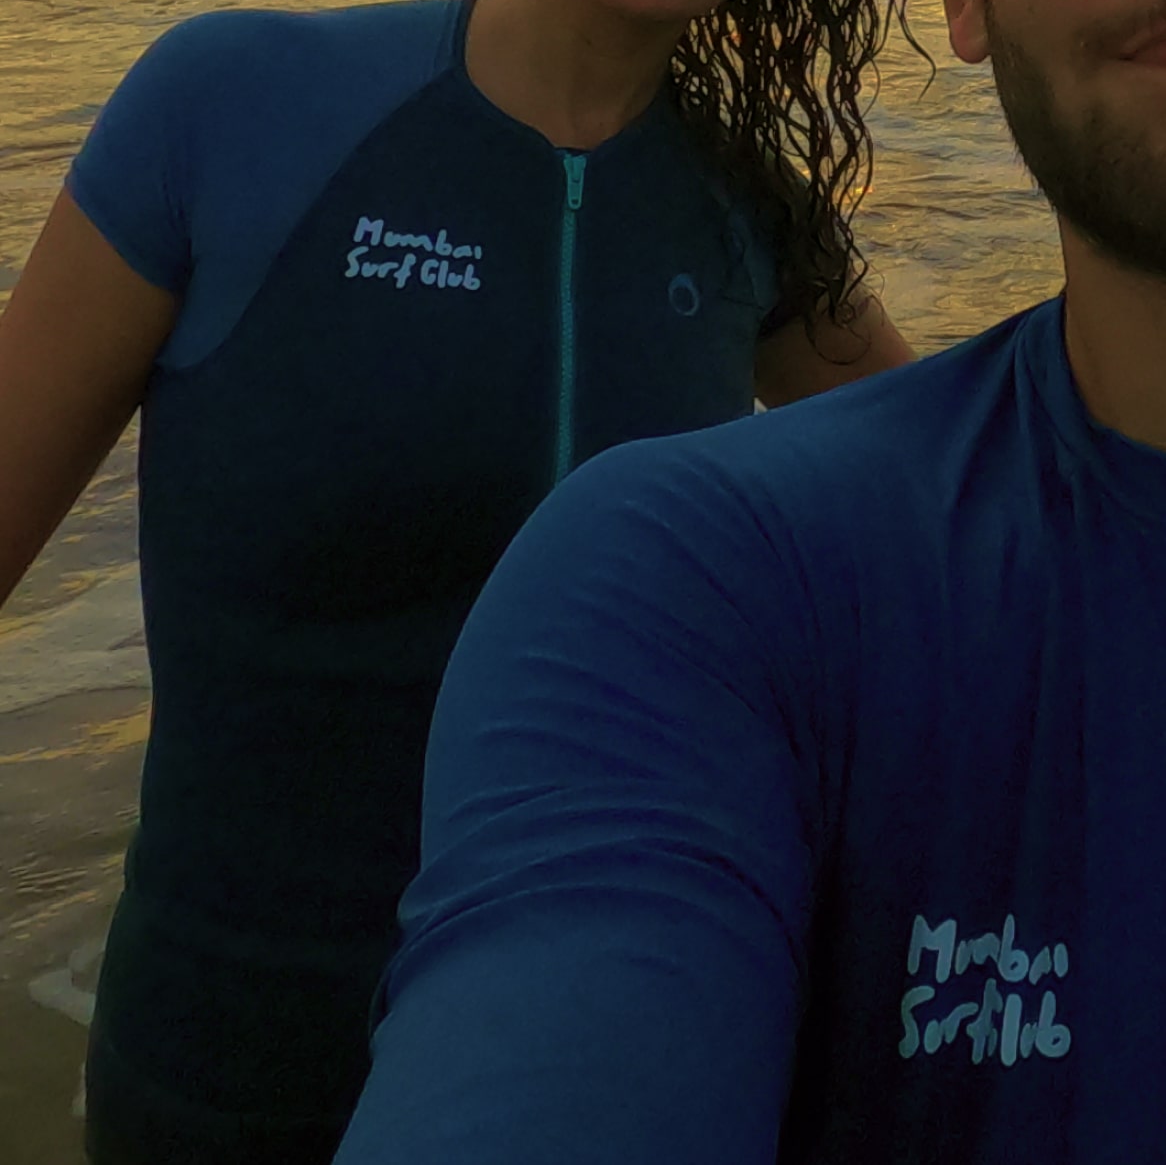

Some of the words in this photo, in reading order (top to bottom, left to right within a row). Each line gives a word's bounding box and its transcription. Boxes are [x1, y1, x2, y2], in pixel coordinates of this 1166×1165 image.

[353, 216, 482, 260] Mumbai
[344, 246, 416, 289] Surf
[420, 258, 481, 291] Club
